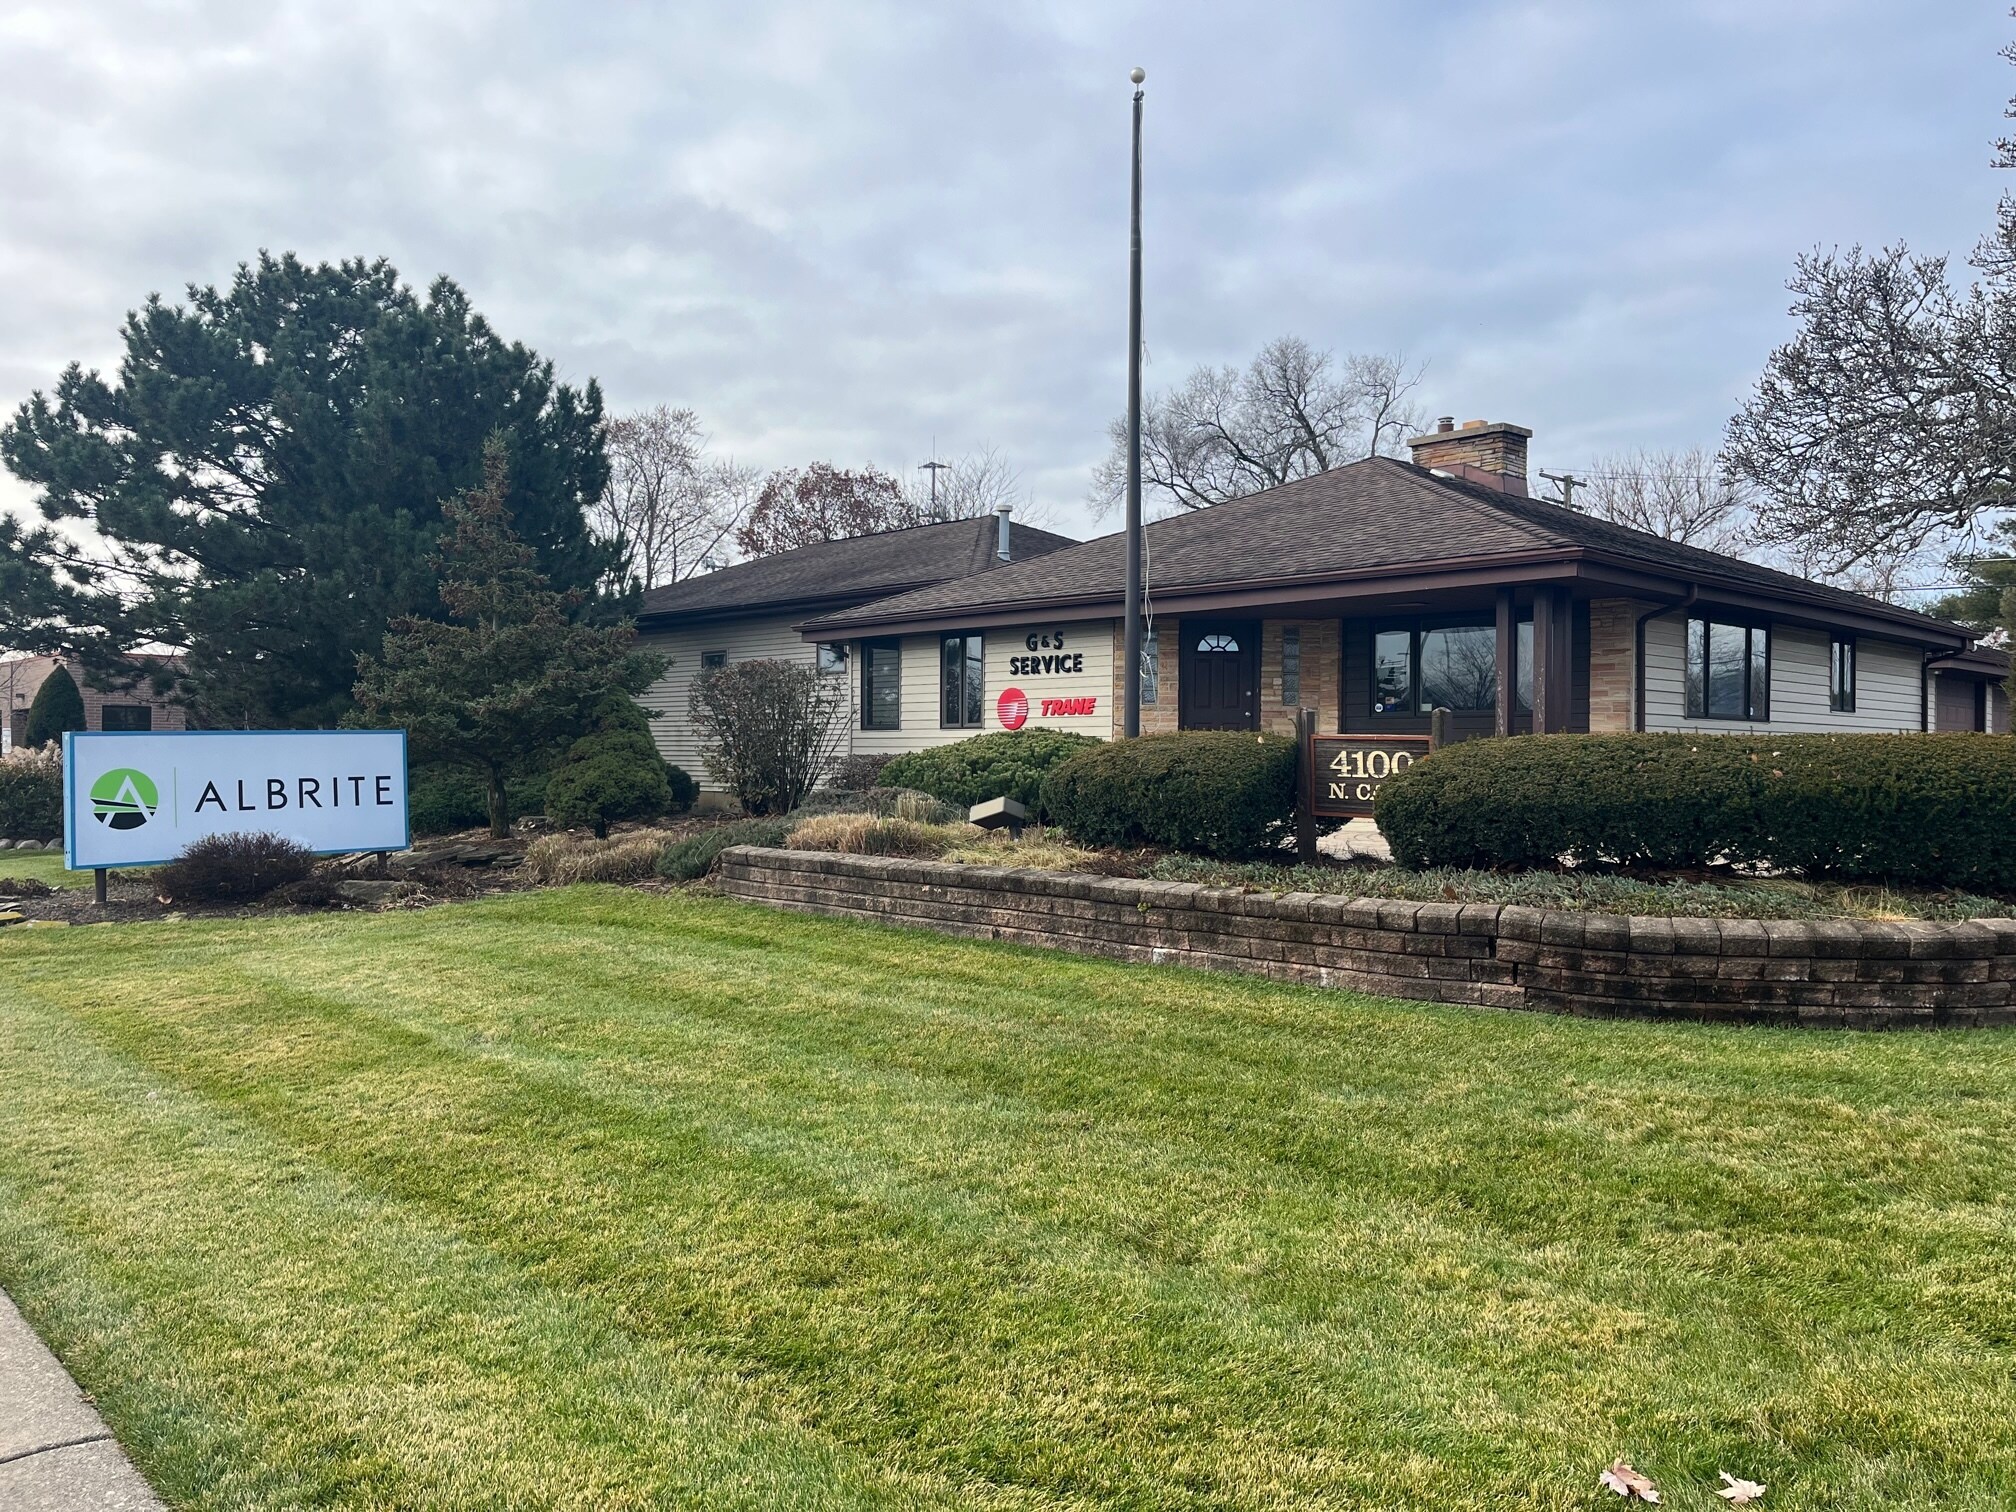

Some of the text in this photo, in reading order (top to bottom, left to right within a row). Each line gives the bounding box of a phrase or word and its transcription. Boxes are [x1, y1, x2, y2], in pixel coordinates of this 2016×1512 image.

[1010, 653, 1083, 675] SERVICE
[1041, 697, 1097, 716] TRANE
[1329, 750, 1414, 778] 4100
[194, 775, 394, 813] ALBRITE
[1328, 782, 1349, 799] N.
